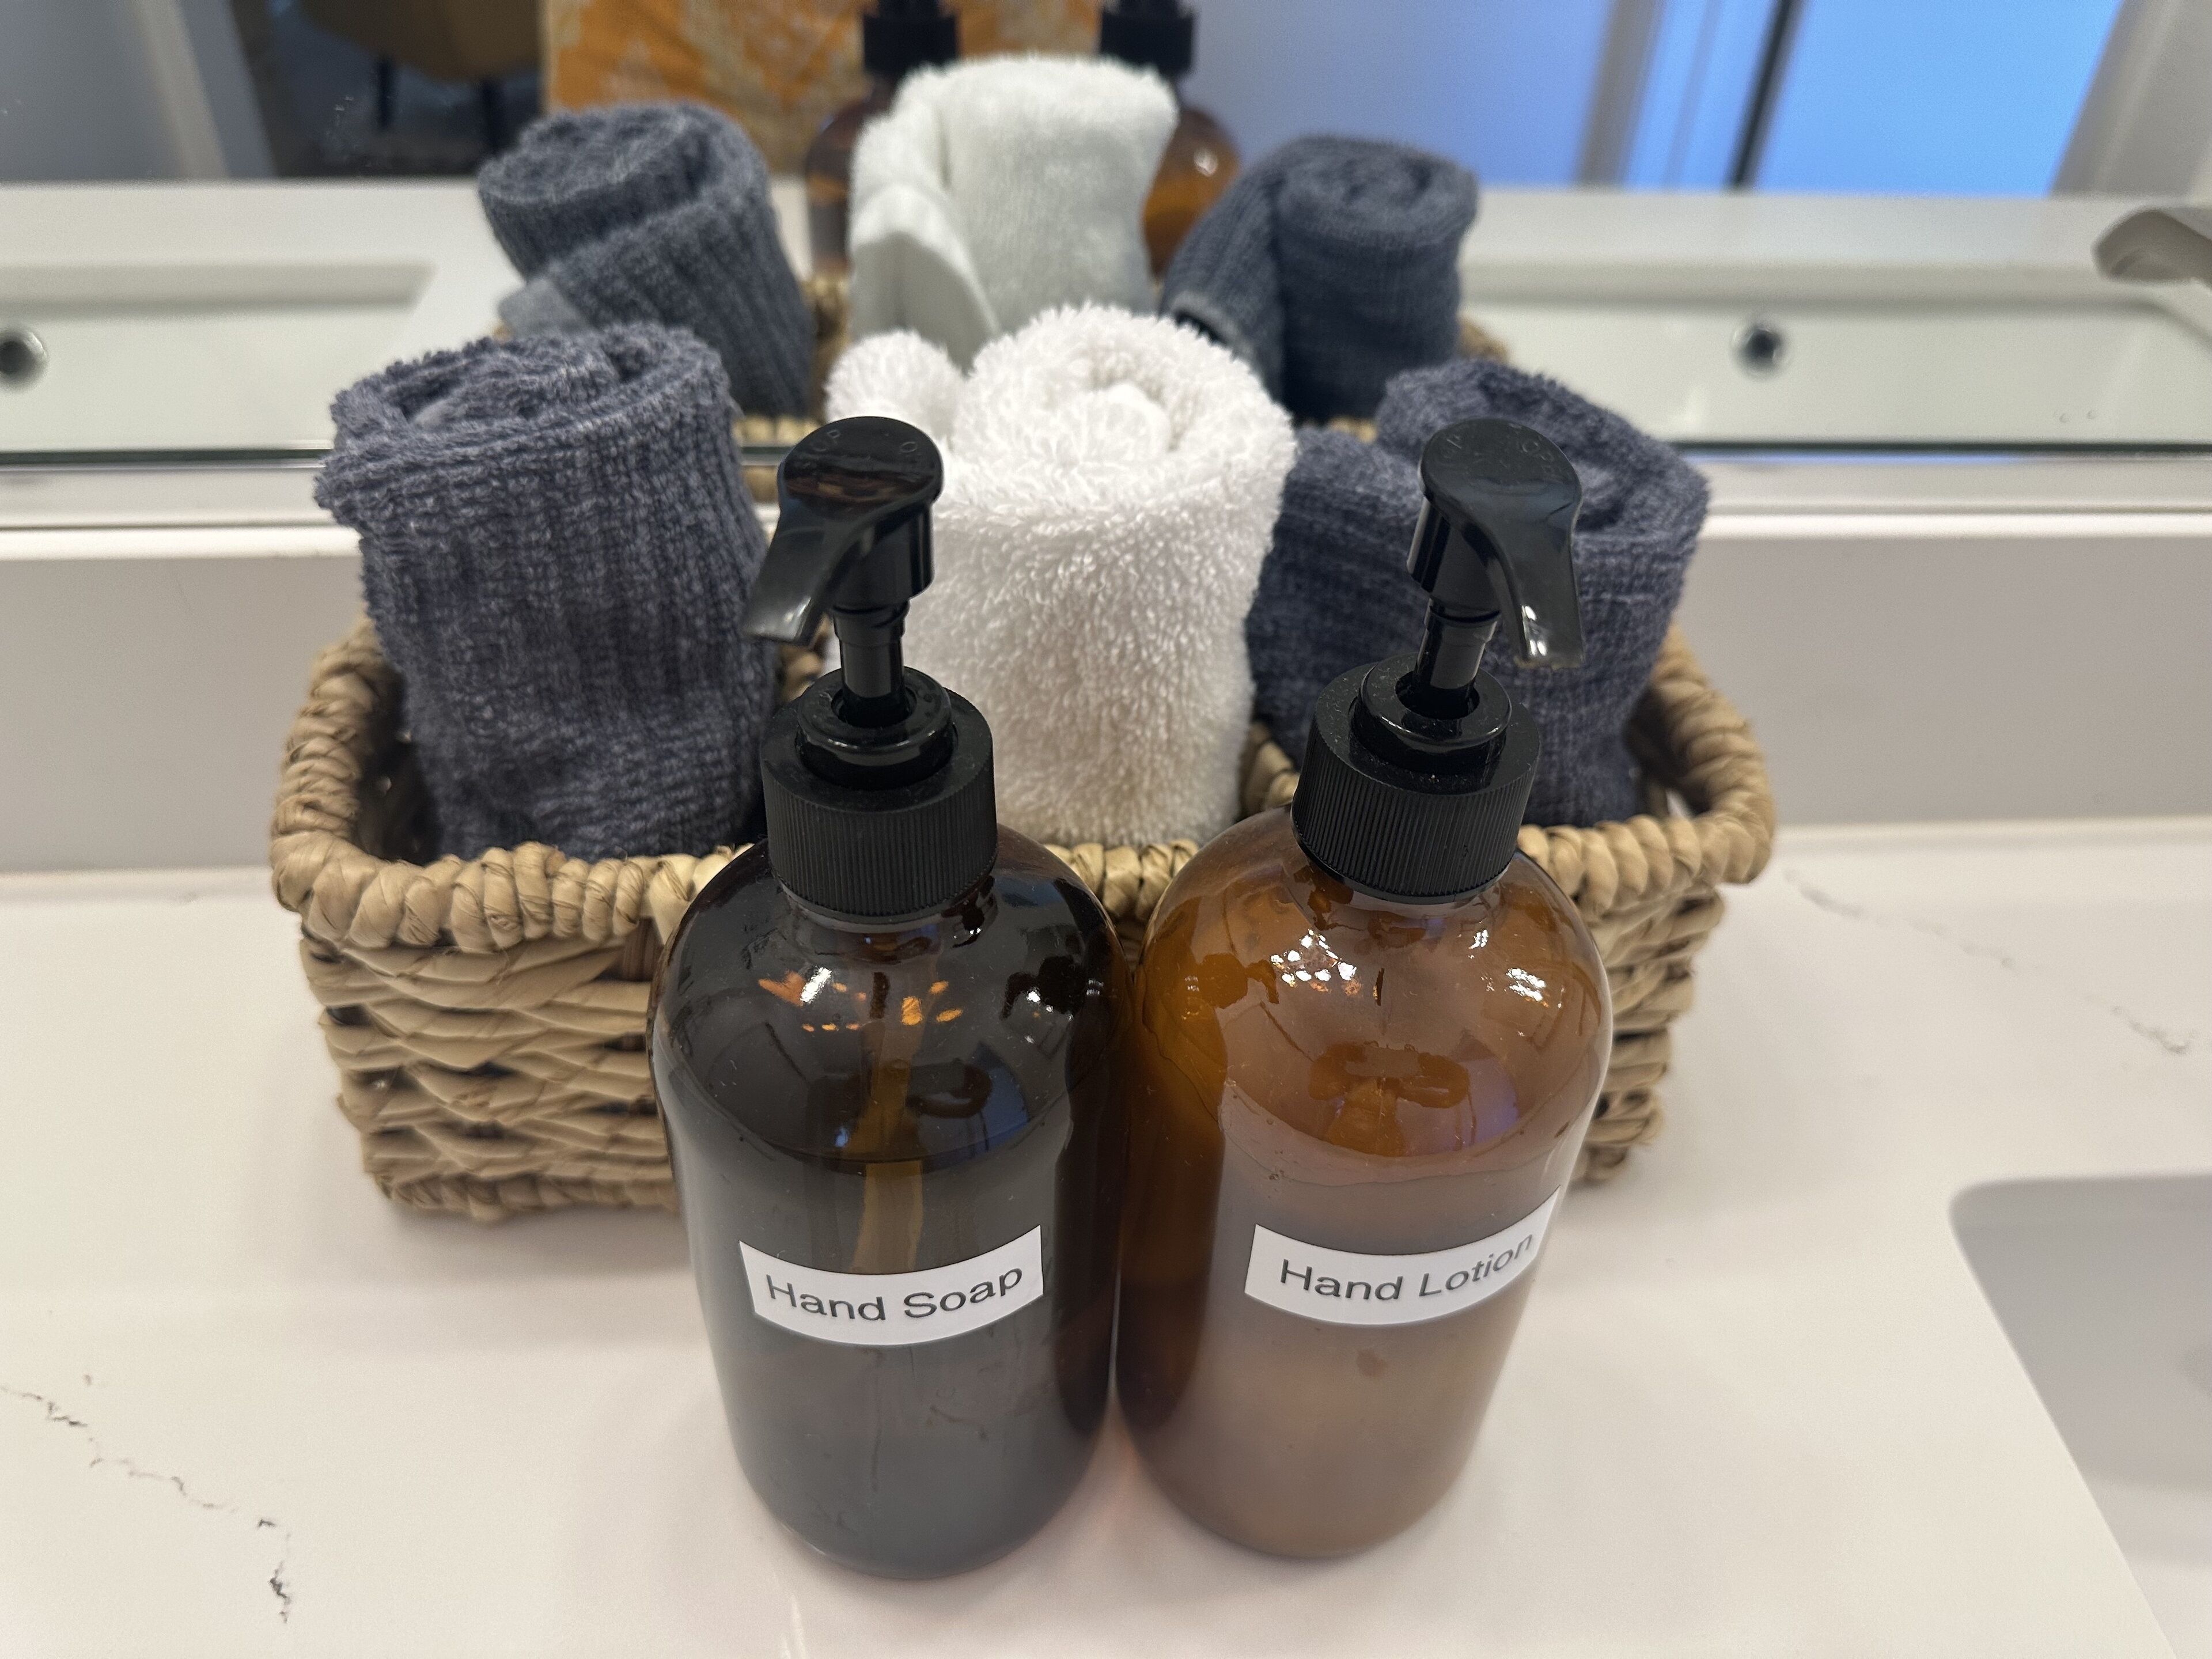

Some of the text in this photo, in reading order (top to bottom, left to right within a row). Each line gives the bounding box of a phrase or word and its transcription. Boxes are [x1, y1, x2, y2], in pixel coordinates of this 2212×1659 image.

[766, 1267, 1022, 1321] Hand Soap
[1279, 1233, 1533, 1301] Hand Lotion
